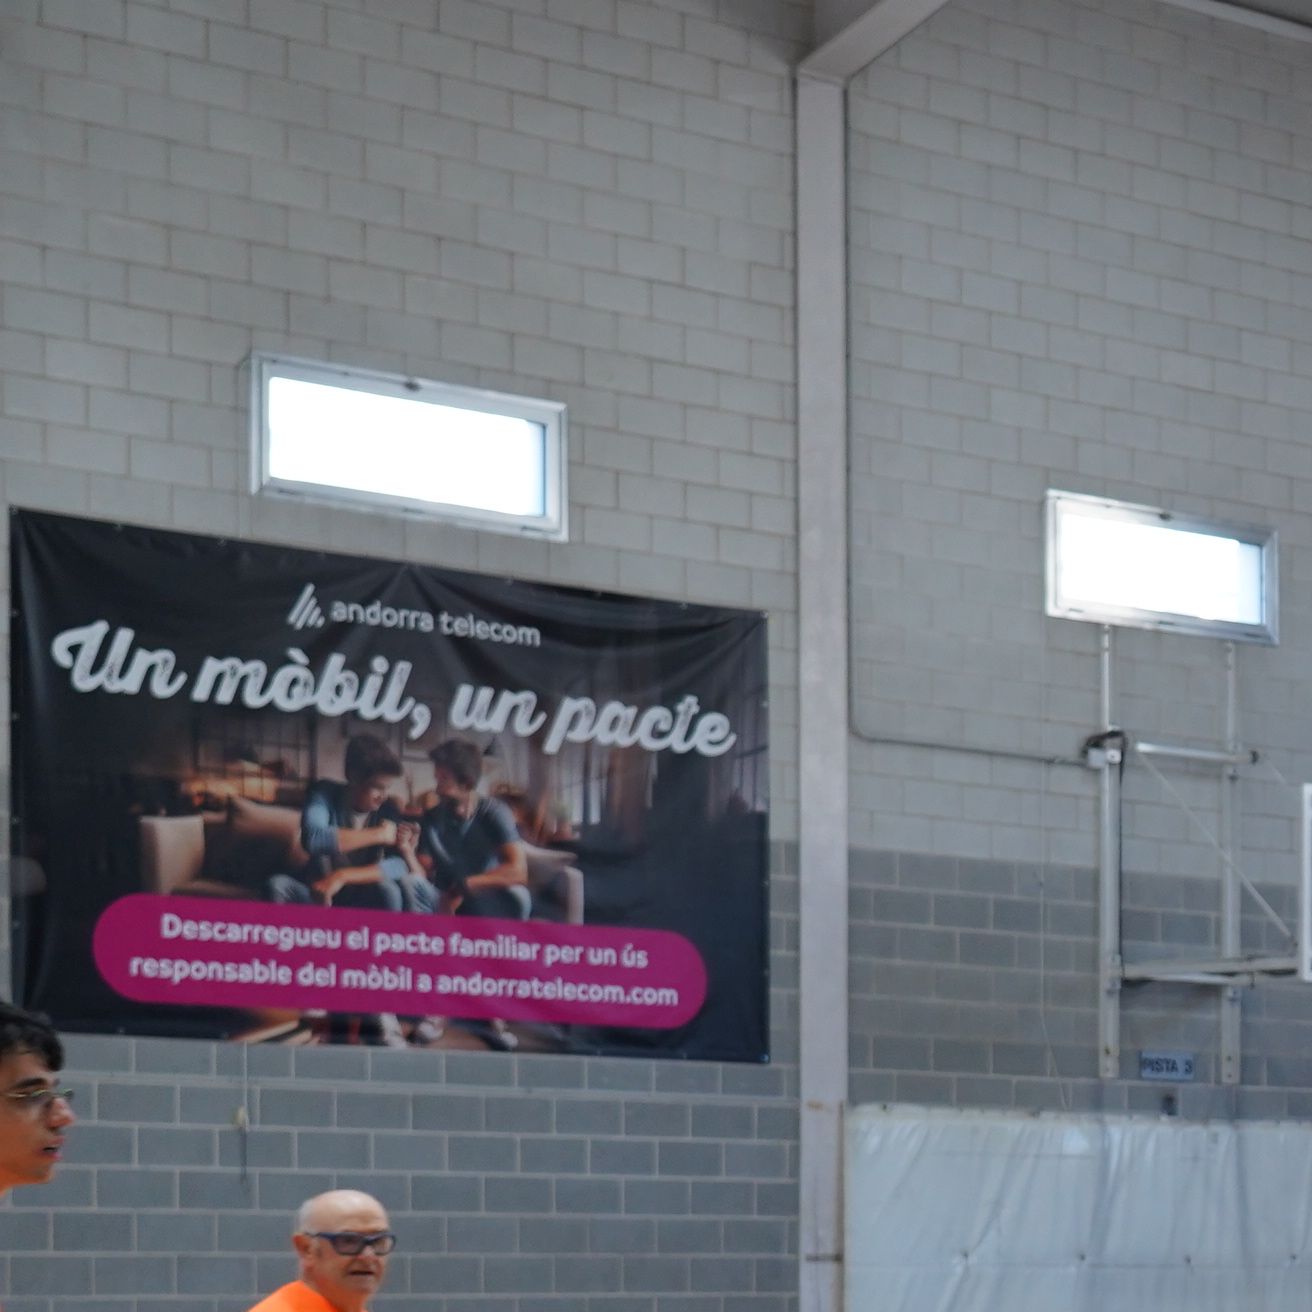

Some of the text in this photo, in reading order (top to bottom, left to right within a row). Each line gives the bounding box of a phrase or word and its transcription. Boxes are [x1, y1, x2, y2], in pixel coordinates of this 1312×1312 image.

[330, 600, 541, 647] andorra telecom
[51, 619, 738, 758] Un mòbil, un pacte
[161, 913, 649, 968] Descarregueu el pacte familiar per un ús
[129, 956, 679, 1006] responsable del mòbil a andorratelecom.com
